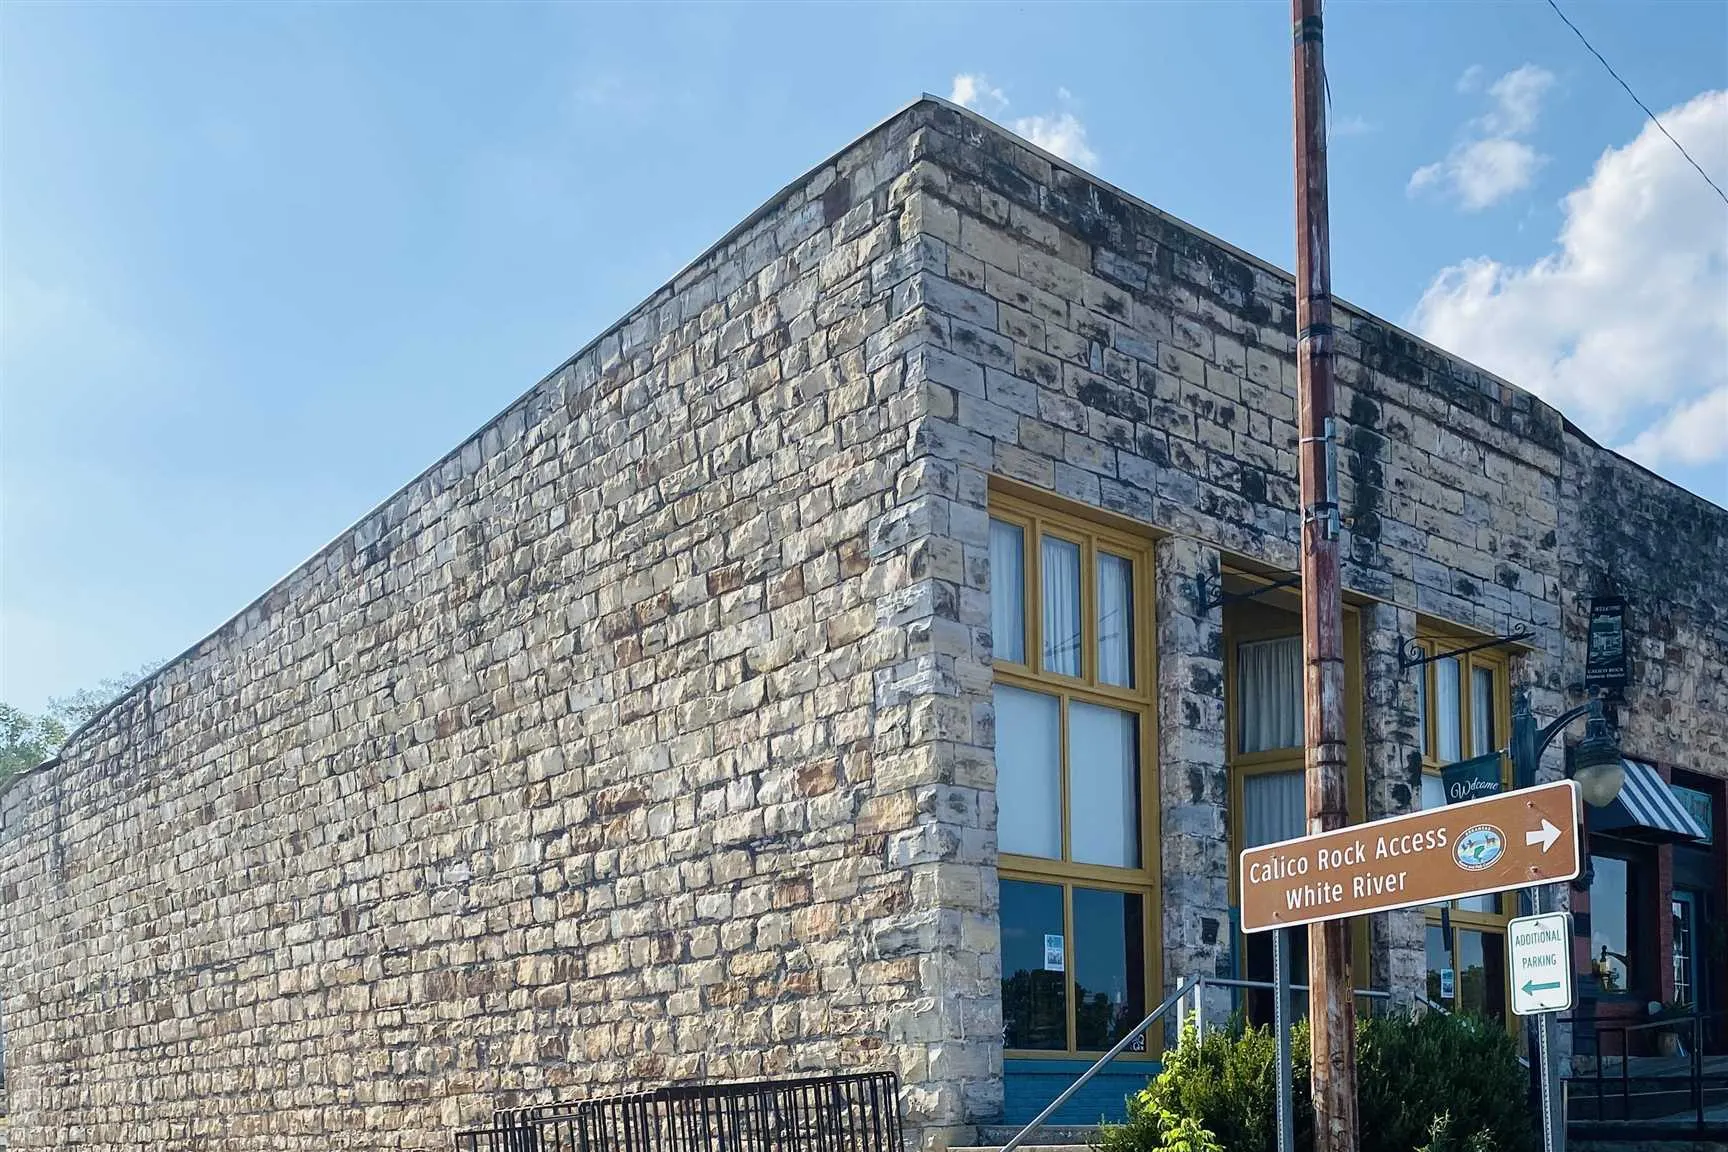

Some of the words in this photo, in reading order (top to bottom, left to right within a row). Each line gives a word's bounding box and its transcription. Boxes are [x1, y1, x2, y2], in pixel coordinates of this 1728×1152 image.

[1450, 776, 1499, 799] Welcome
[1249, 855, 1308, 884] Calico
[1318, 840, 1366, 871] Rock
[1376, 828, 1448, 860] Access
[1286, 882, 1343, 910] White
[1353, 871, 1407, 899] River
[1515, 929, 1561, 947] ADDITIONAL
[1522, 953, 1557, 969] PARKING
